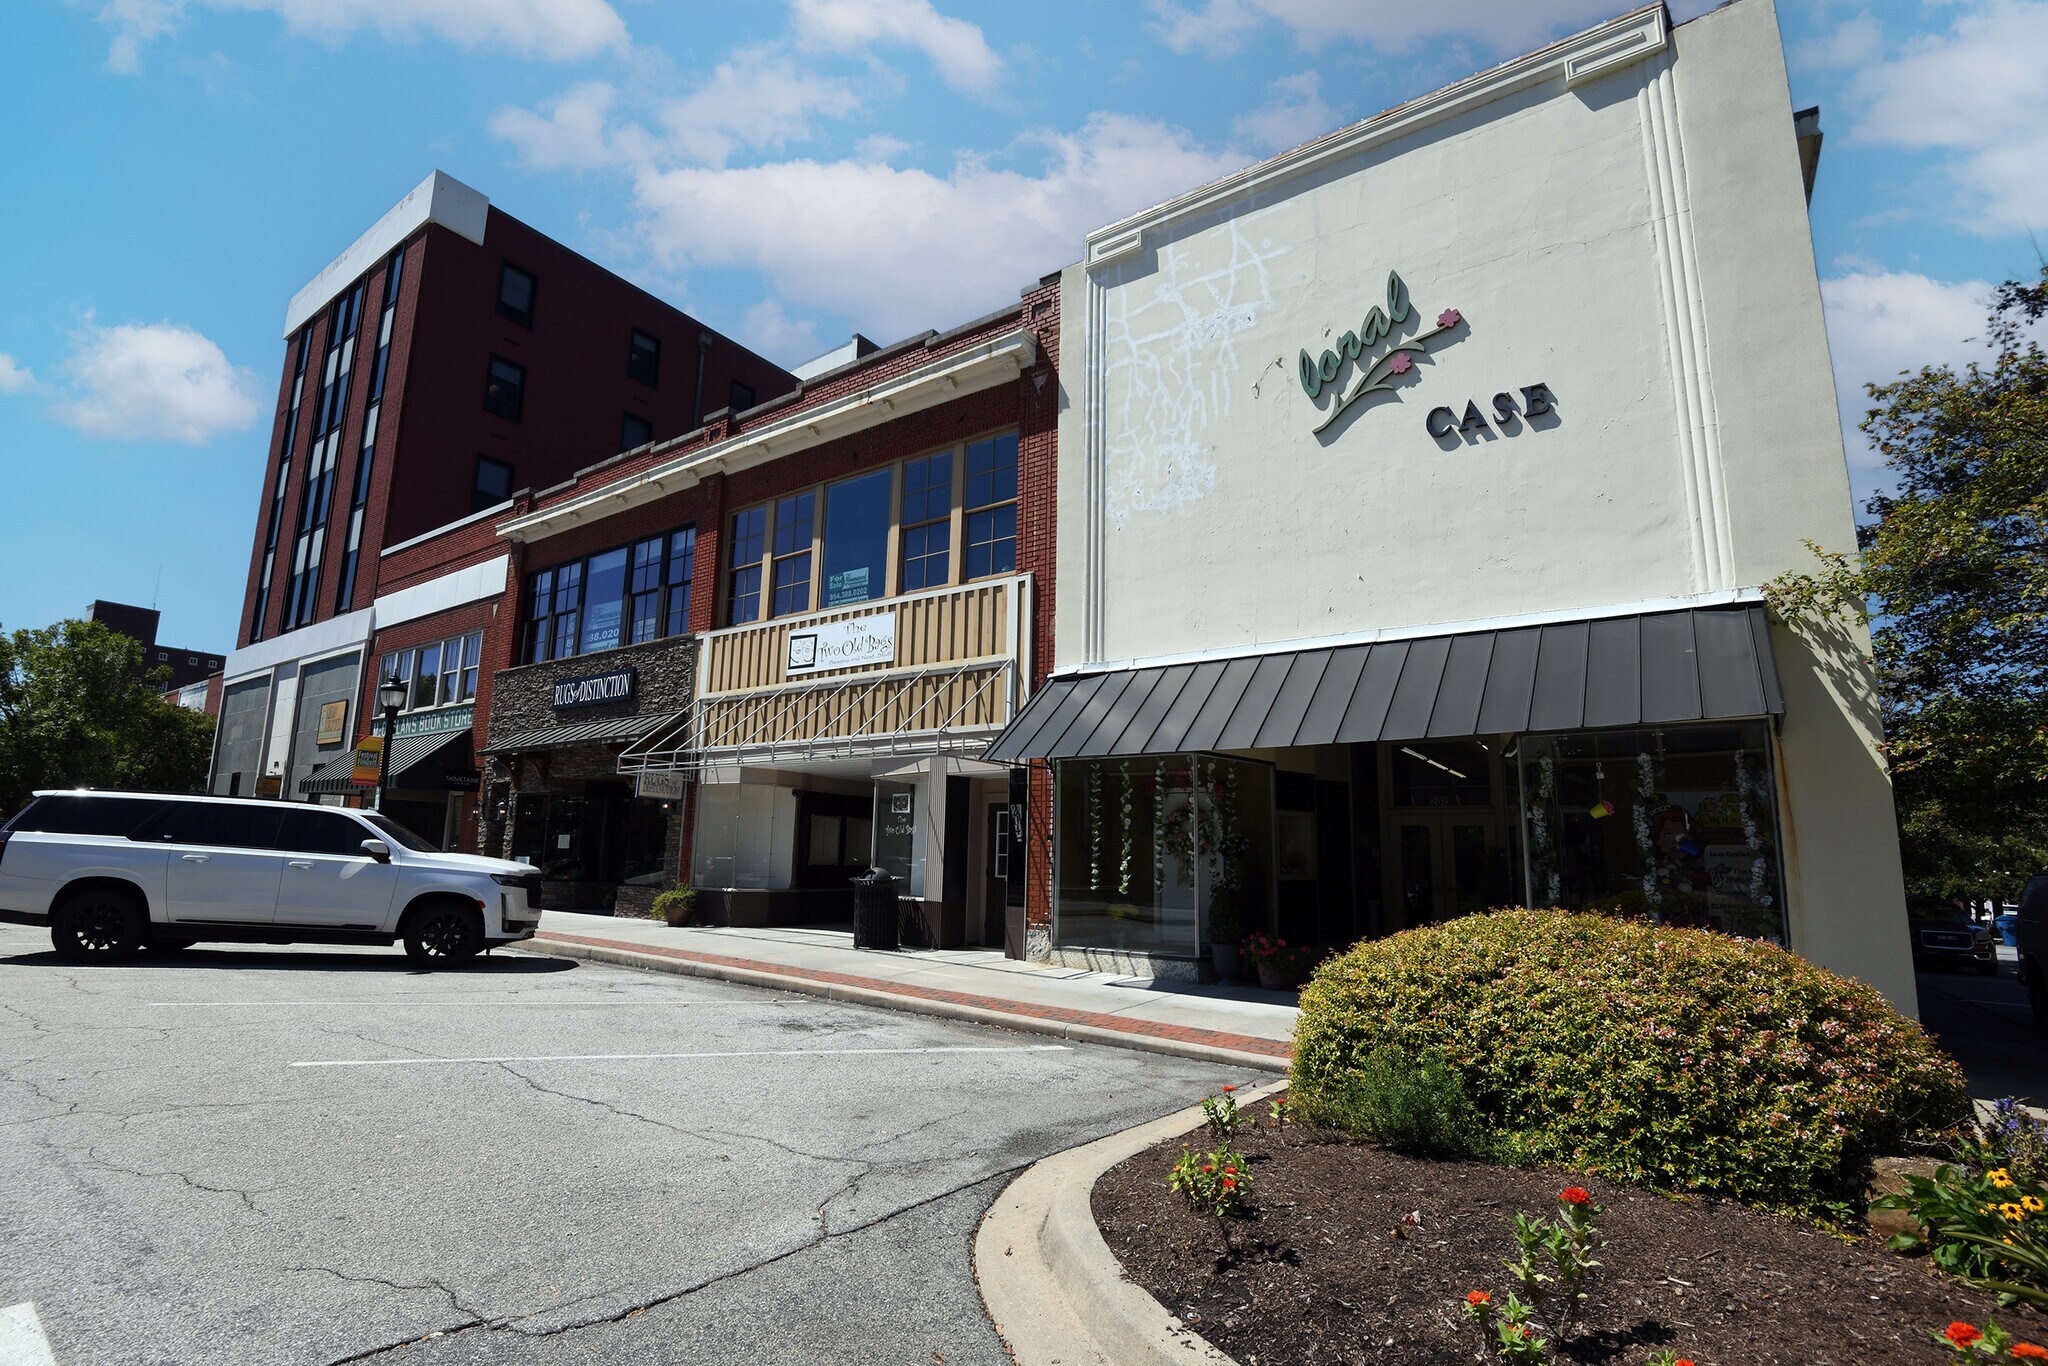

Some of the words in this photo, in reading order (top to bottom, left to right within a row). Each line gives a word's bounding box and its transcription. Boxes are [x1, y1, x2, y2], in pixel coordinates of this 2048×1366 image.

[1425, 382, 1552, 438] CASE
[829, 575, 843, 583] For
[829, 582, 843, 590] Sale
[844, 622, 867, 635] The
[818, 641, 841, 663] Two
[842, 636, 864, 657] Old
[865, 634, 893, 654] Bags
[554, 682, 576, 706] RUGS
[579, 673, 631, 702] DISTINCTION
[419, 712, 442, 732] BOOK
[444, 707, 475, 729] STORE
[643, 772, 670, 788] RUGS
